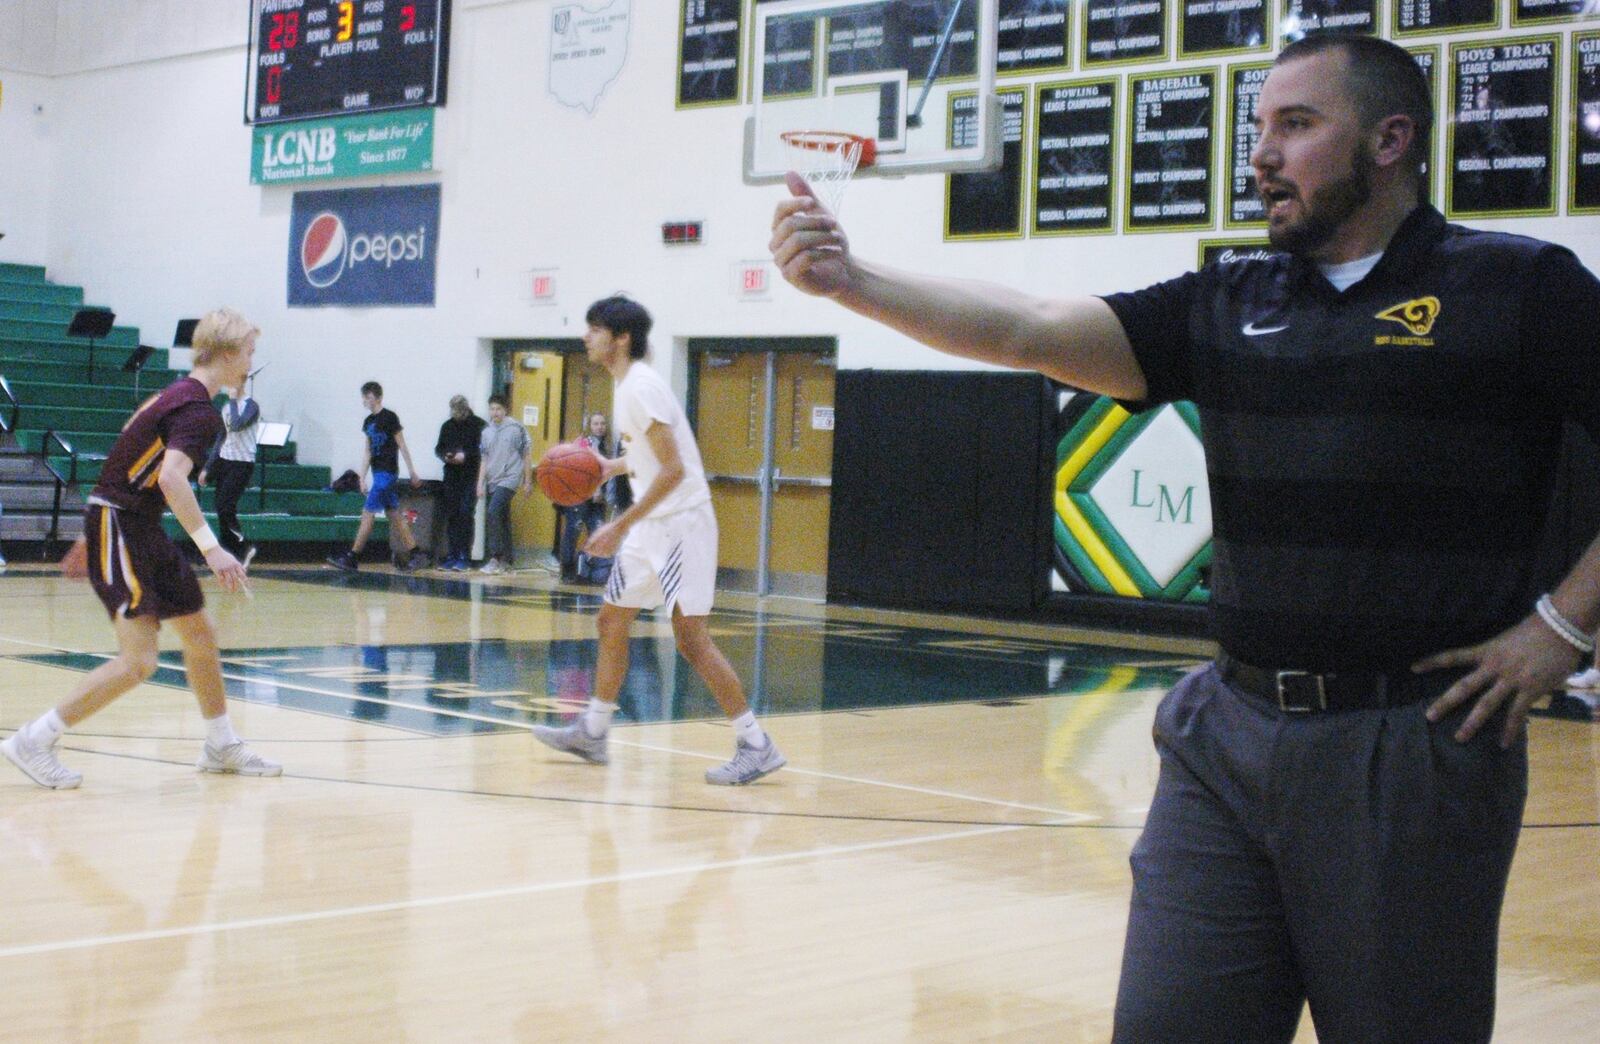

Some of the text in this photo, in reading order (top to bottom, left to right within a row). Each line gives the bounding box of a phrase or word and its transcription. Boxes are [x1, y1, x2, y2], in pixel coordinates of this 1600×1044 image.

[336, 2, 353, 42] 3
[320, 38, 379, 57] PLAYER FOUL
[1459, 43, 1552, 62] BOYS TRACK
[260, 53, 285, 66] FOULS
[1461, 57, 1549, 74] LEAGUE CHAMPIONSHIPS
[1143, 76, 1202, 92] BASEBALL
[343, 93, 370, 108] GAME
[1055, 87, 1099, 99] BOWLING
[260, 106, 280, 117] WON
[368, 128, 389, 141] Bank
[390, 124, 404, 140] For
[262, 127, 337, 168] LCNB
[360, 148, 407, 165] Since 1877
[262, 162, 335, 180] National Bank
[349, 227, 425, 268] pepsi
[744, 269, 764, 289] EXIT
